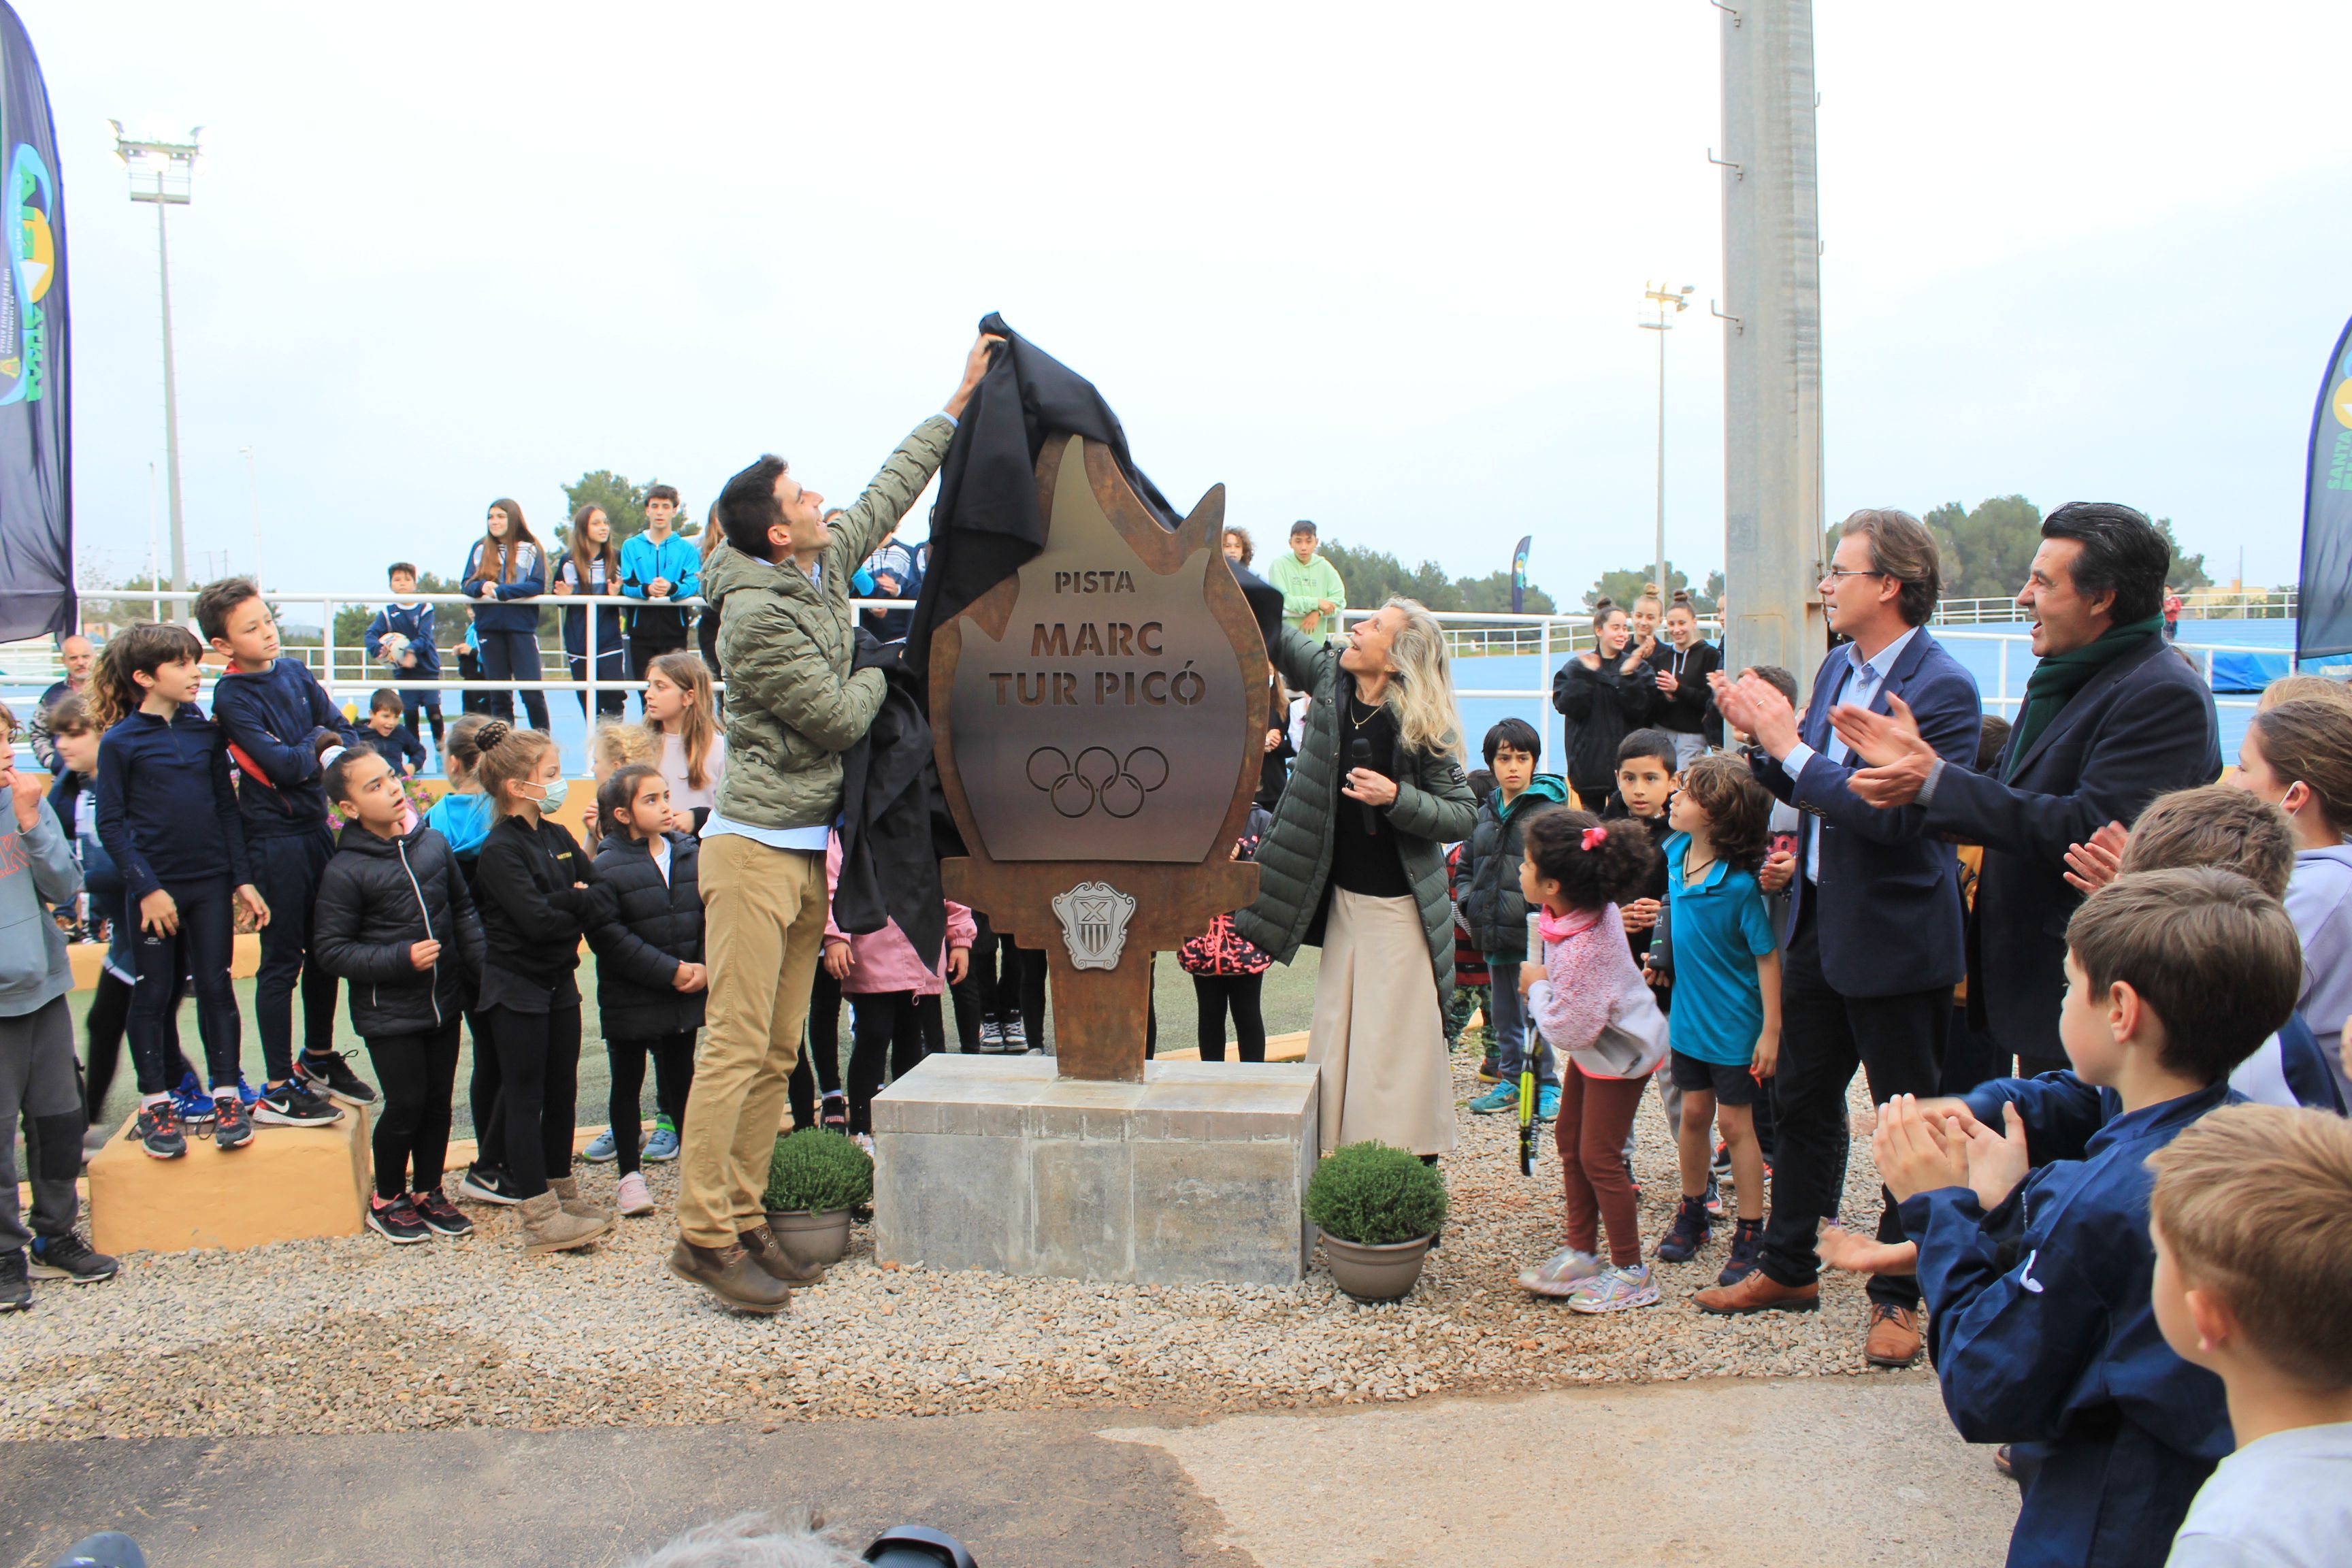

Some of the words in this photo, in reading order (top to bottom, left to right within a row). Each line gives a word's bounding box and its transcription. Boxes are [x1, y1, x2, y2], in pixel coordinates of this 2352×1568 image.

[2327, 431, 2352, 489] SANTA
[1055, 570, 1135, 594] PISTA
[1030, 621, 1163, 657] MARC
[989, 672, 1078, 706] TUR
[1095, 660, 1206, 706] PICÓ
